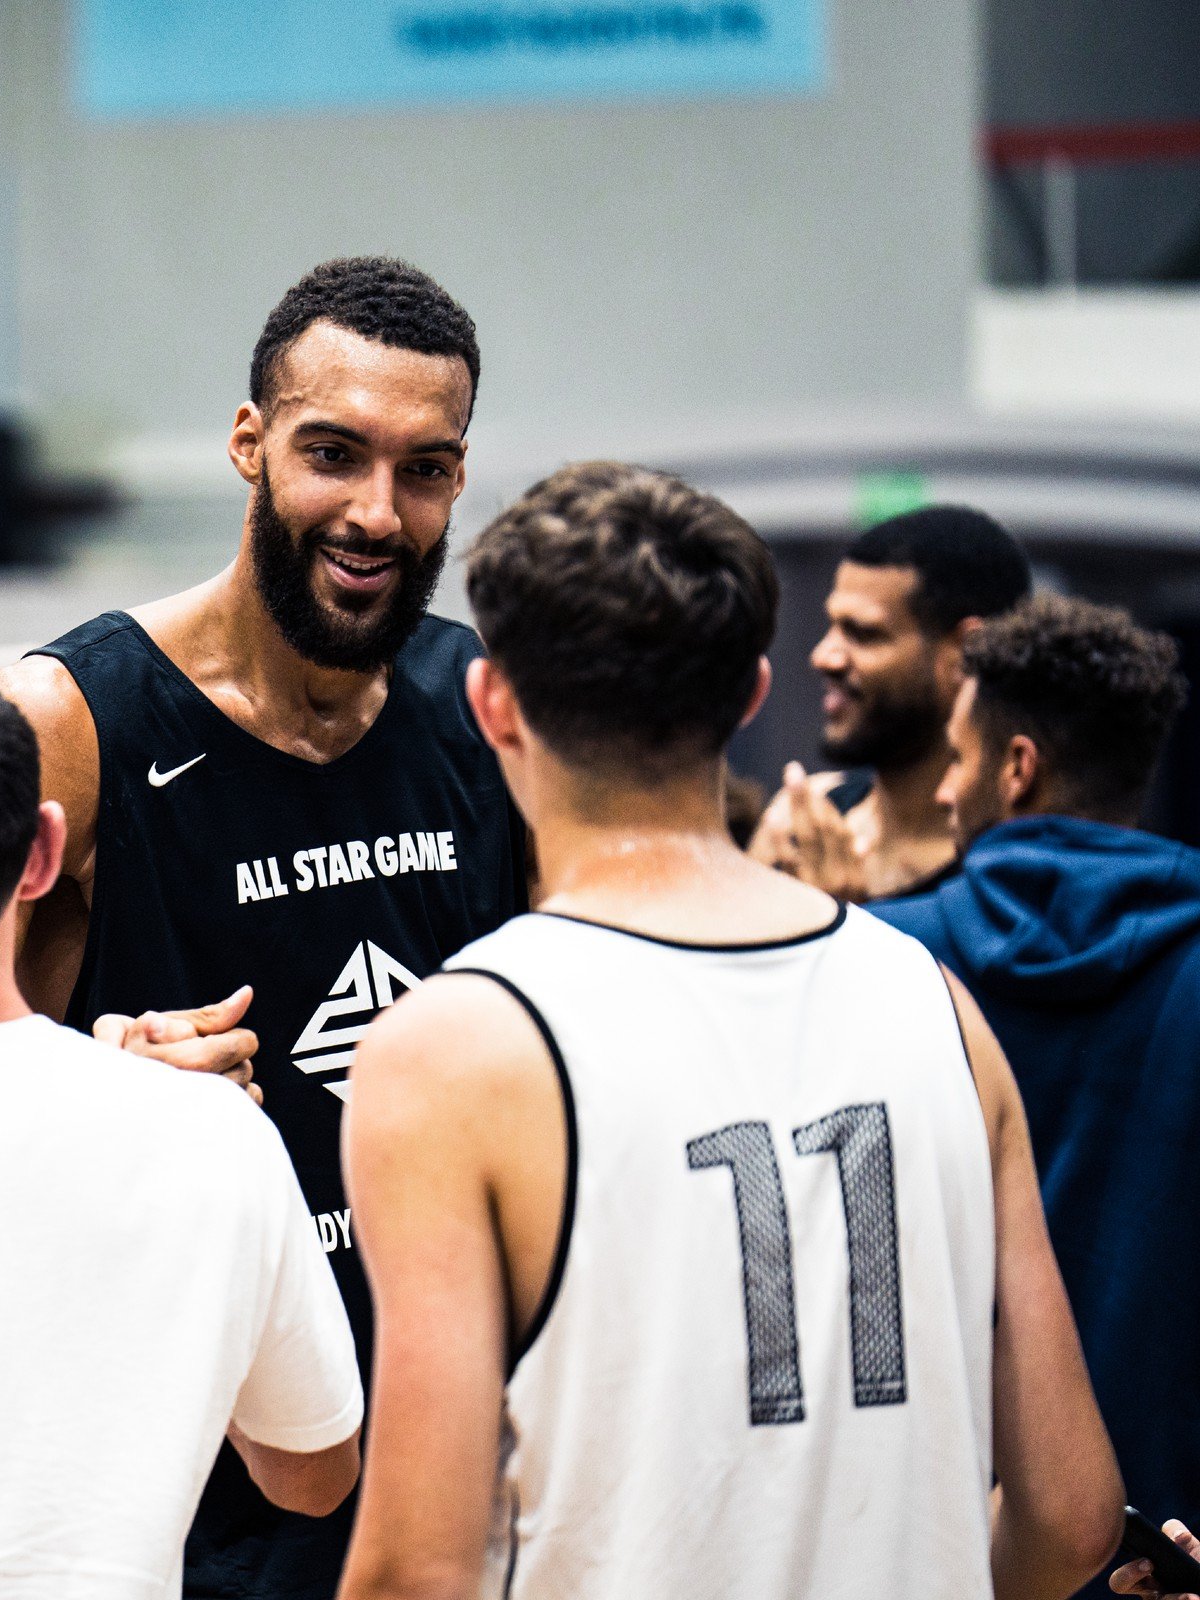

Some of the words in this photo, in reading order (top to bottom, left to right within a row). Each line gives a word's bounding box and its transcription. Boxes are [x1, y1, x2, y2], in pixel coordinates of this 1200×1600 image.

[236, 856, 289, 904] ALL
[293, 840, 375, 892] STAR
[374, 830, 458, 877] GAME
[686, 1101, 907, 1426] 11
